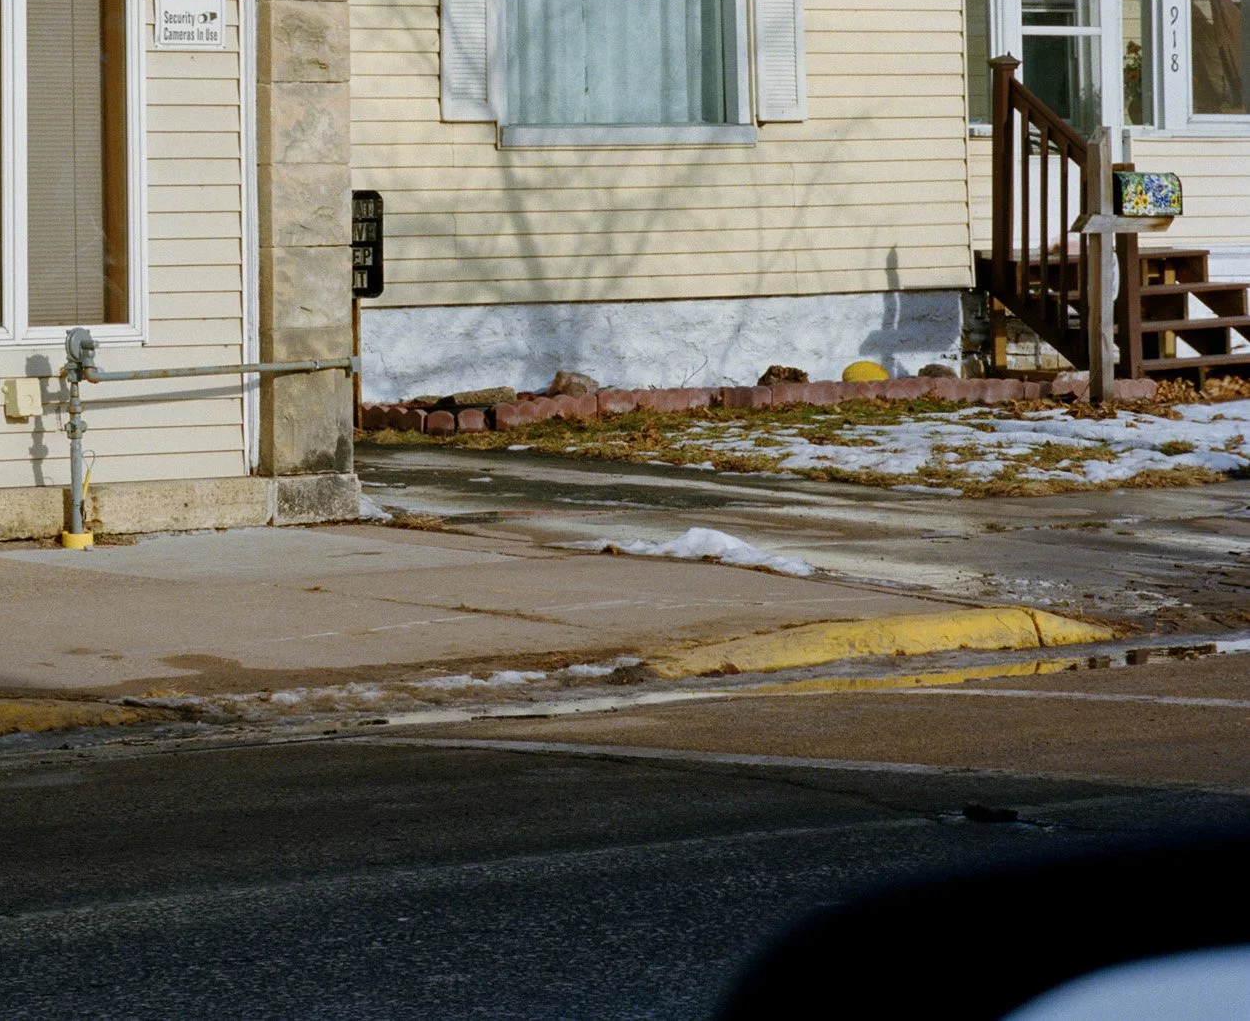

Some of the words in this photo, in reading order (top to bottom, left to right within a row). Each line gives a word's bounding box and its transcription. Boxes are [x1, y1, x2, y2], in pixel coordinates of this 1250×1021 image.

[163, 10, 195, 27] Security
[163, 27, 195, 41] Cameras
[205, 28, 218, 41] Use
[1170, 6, 1179, 72] 918
